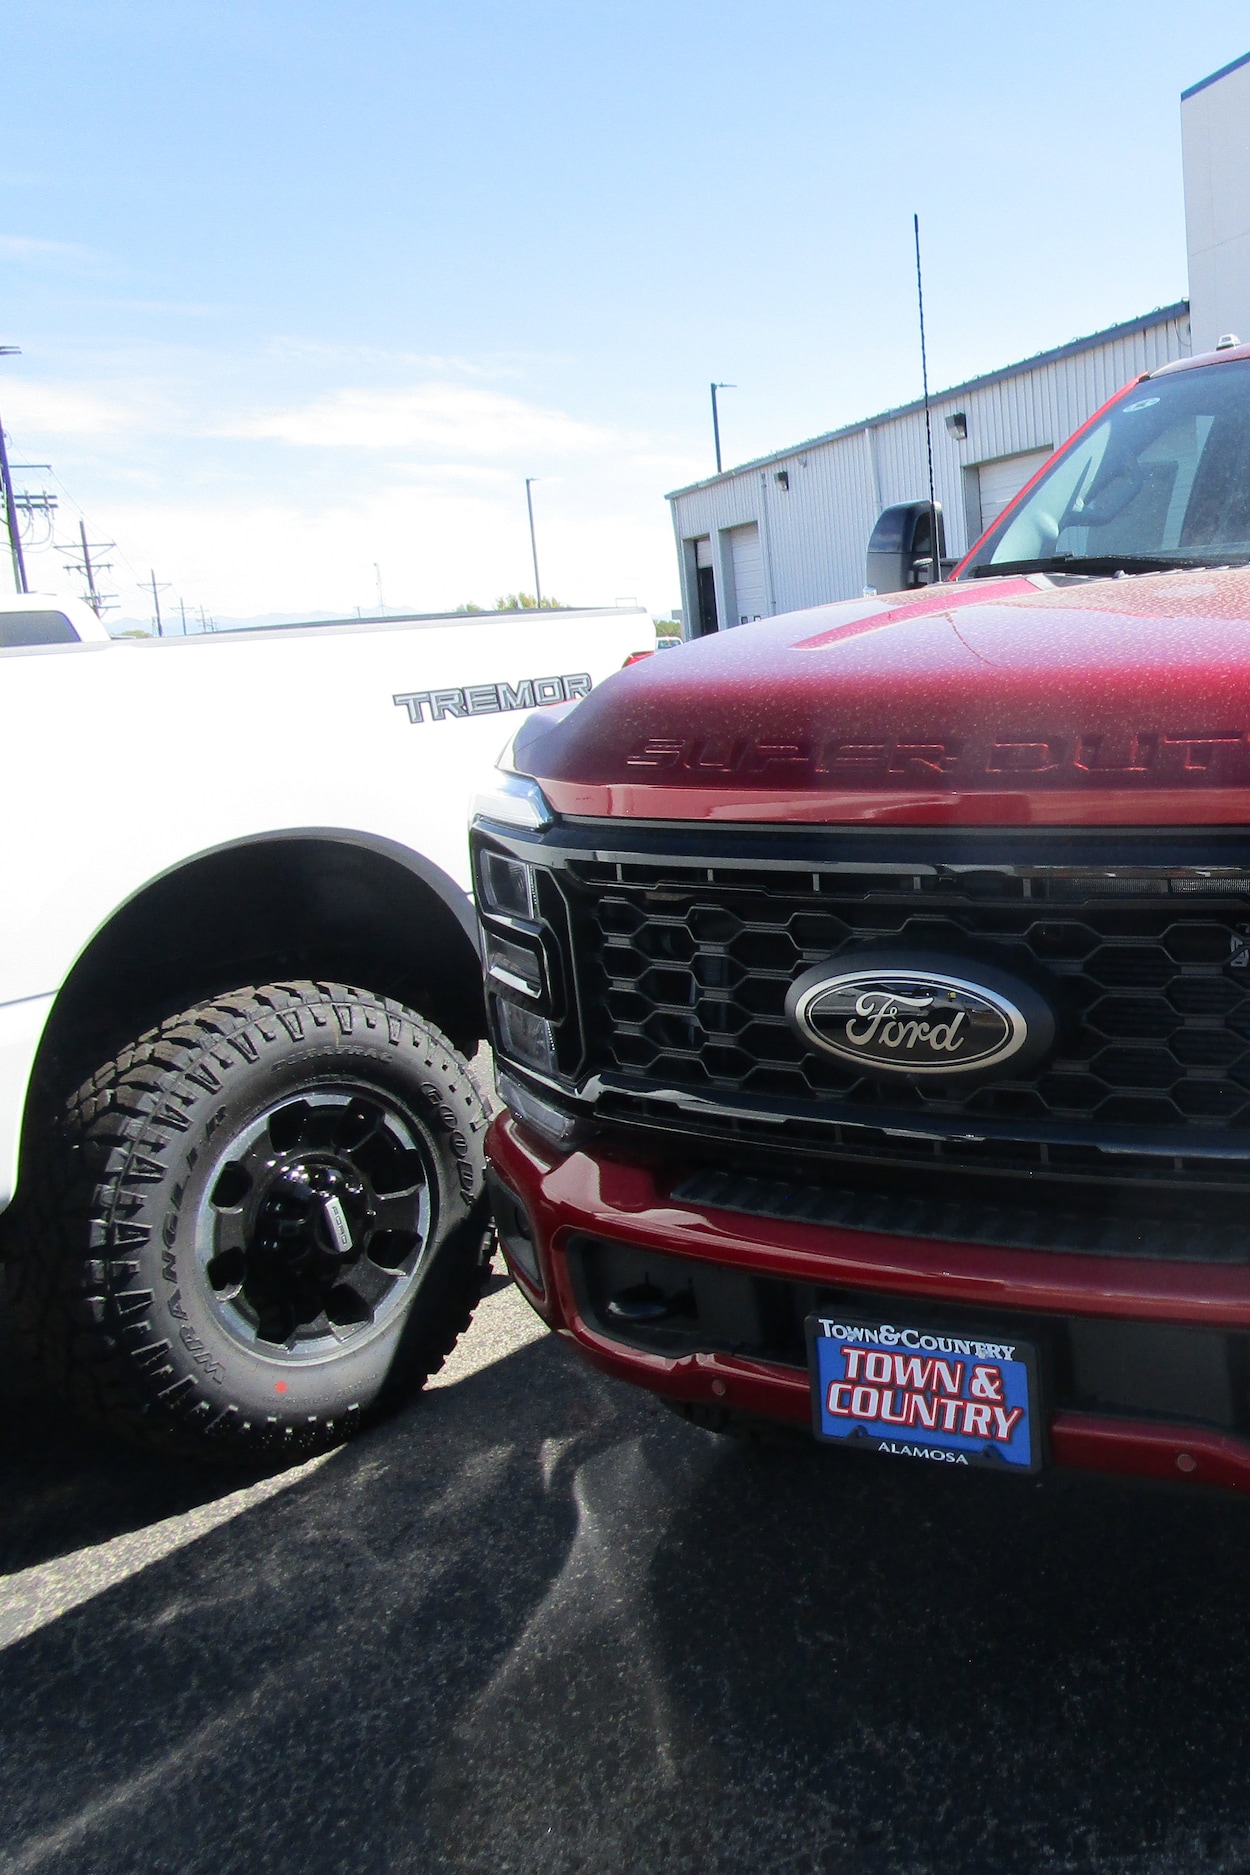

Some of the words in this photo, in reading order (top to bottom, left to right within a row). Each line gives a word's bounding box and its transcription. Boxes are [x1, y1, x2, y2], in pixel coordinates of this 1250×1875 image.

[392, 672, 593, 724] TREMOR
[626, 738, 960, 773] SUPER
[845, 991, 966, 1051] Ford
[331, 1205, 348, 1245] FORD
[840, 1346, 964, 1396] TOWN
[969, 1362, 1005, 1402] &
[826, 1381, 1023, 1441] COUNTRY
[878, 1441, 970, 1466] ALAMOSA
